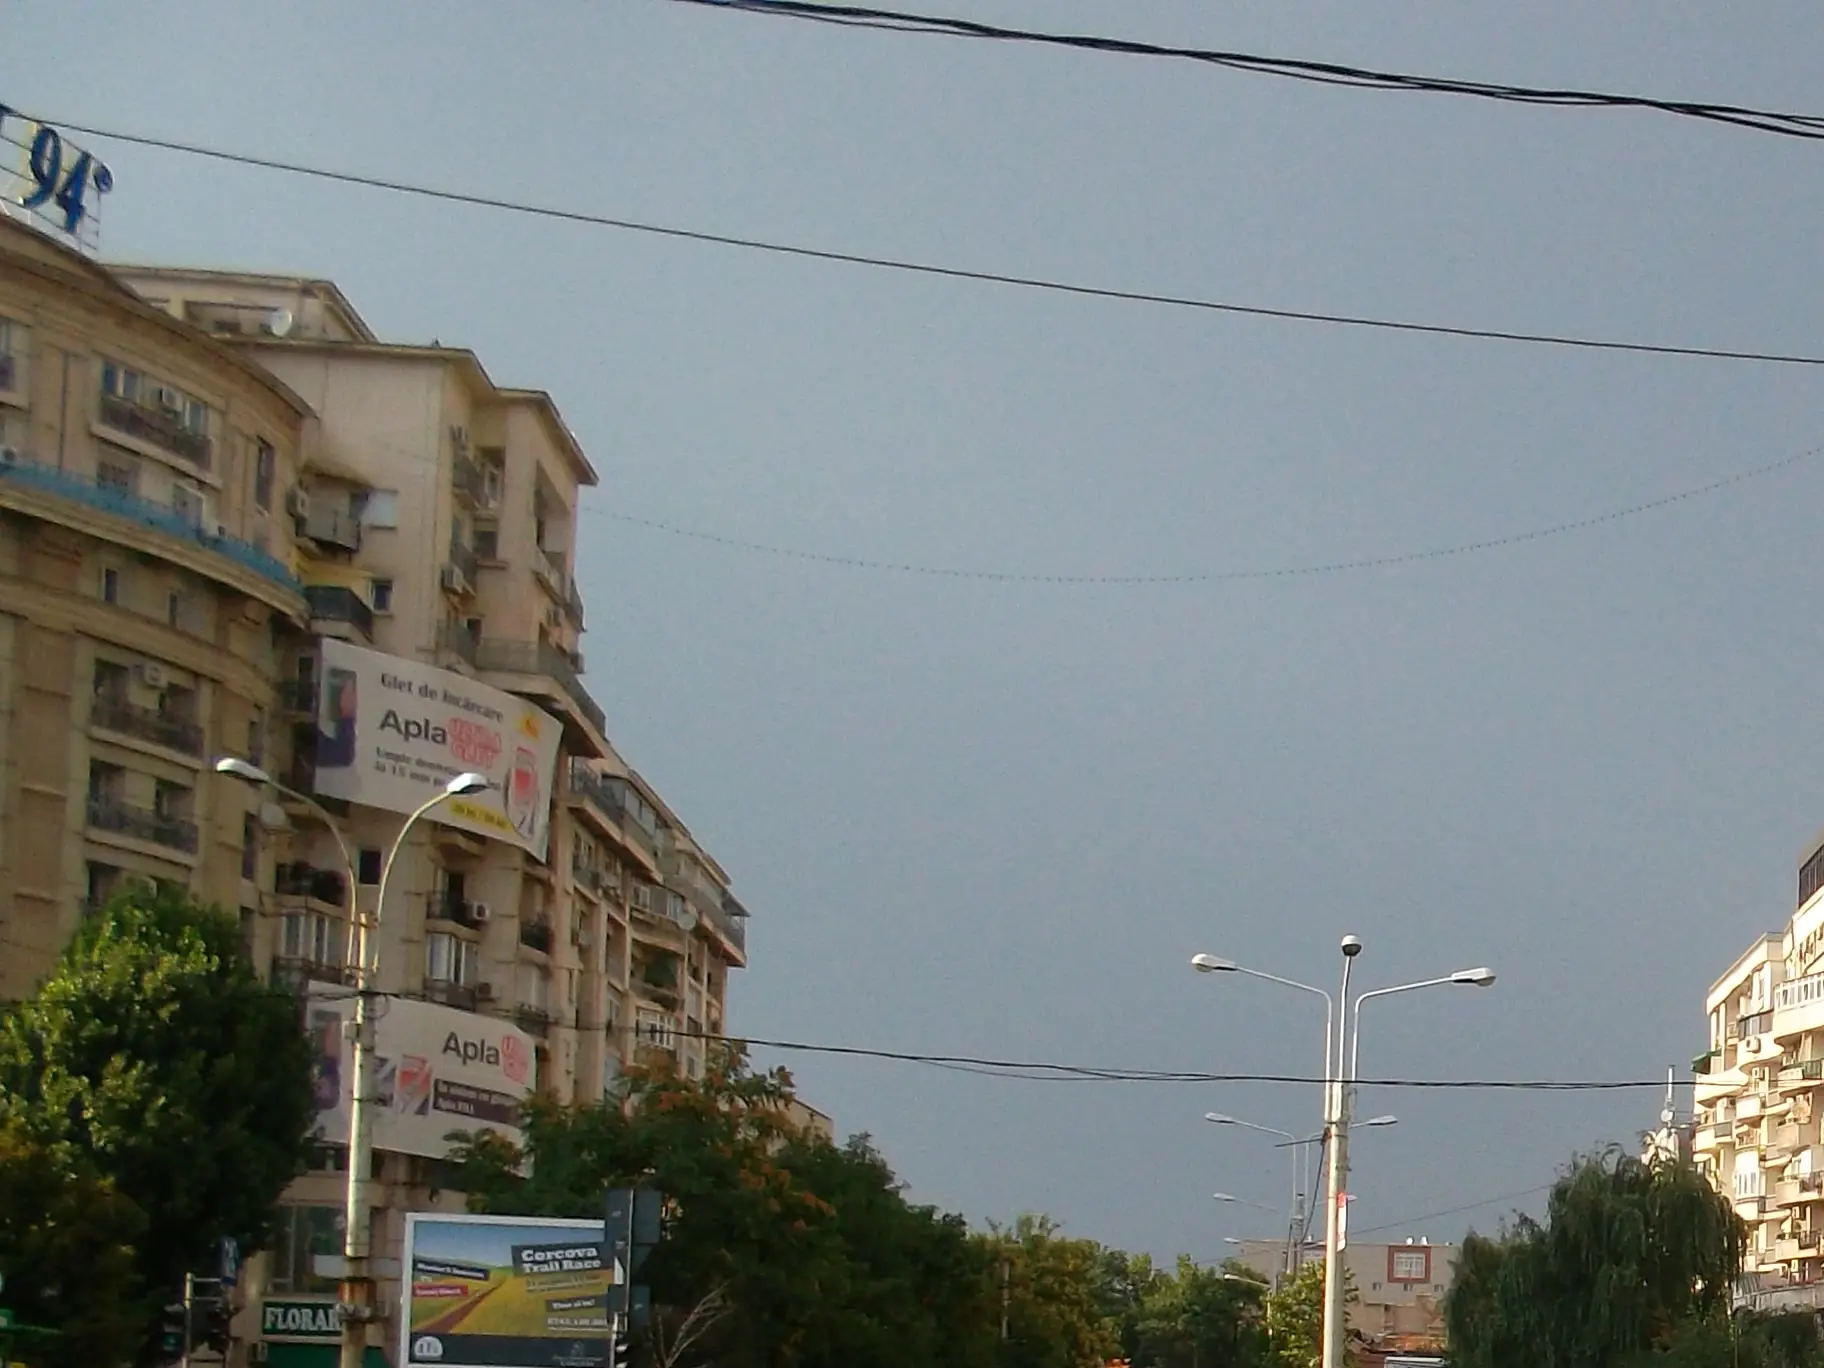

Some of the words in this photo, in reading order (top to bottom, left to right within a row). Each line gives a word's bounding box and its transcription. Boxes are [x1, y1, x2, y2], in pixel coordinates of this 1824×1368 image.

[379, 709, 447, 746] Apla
[443, 1031, 500, 1066] Apla
[562, 1259, 601, 1271] Race
